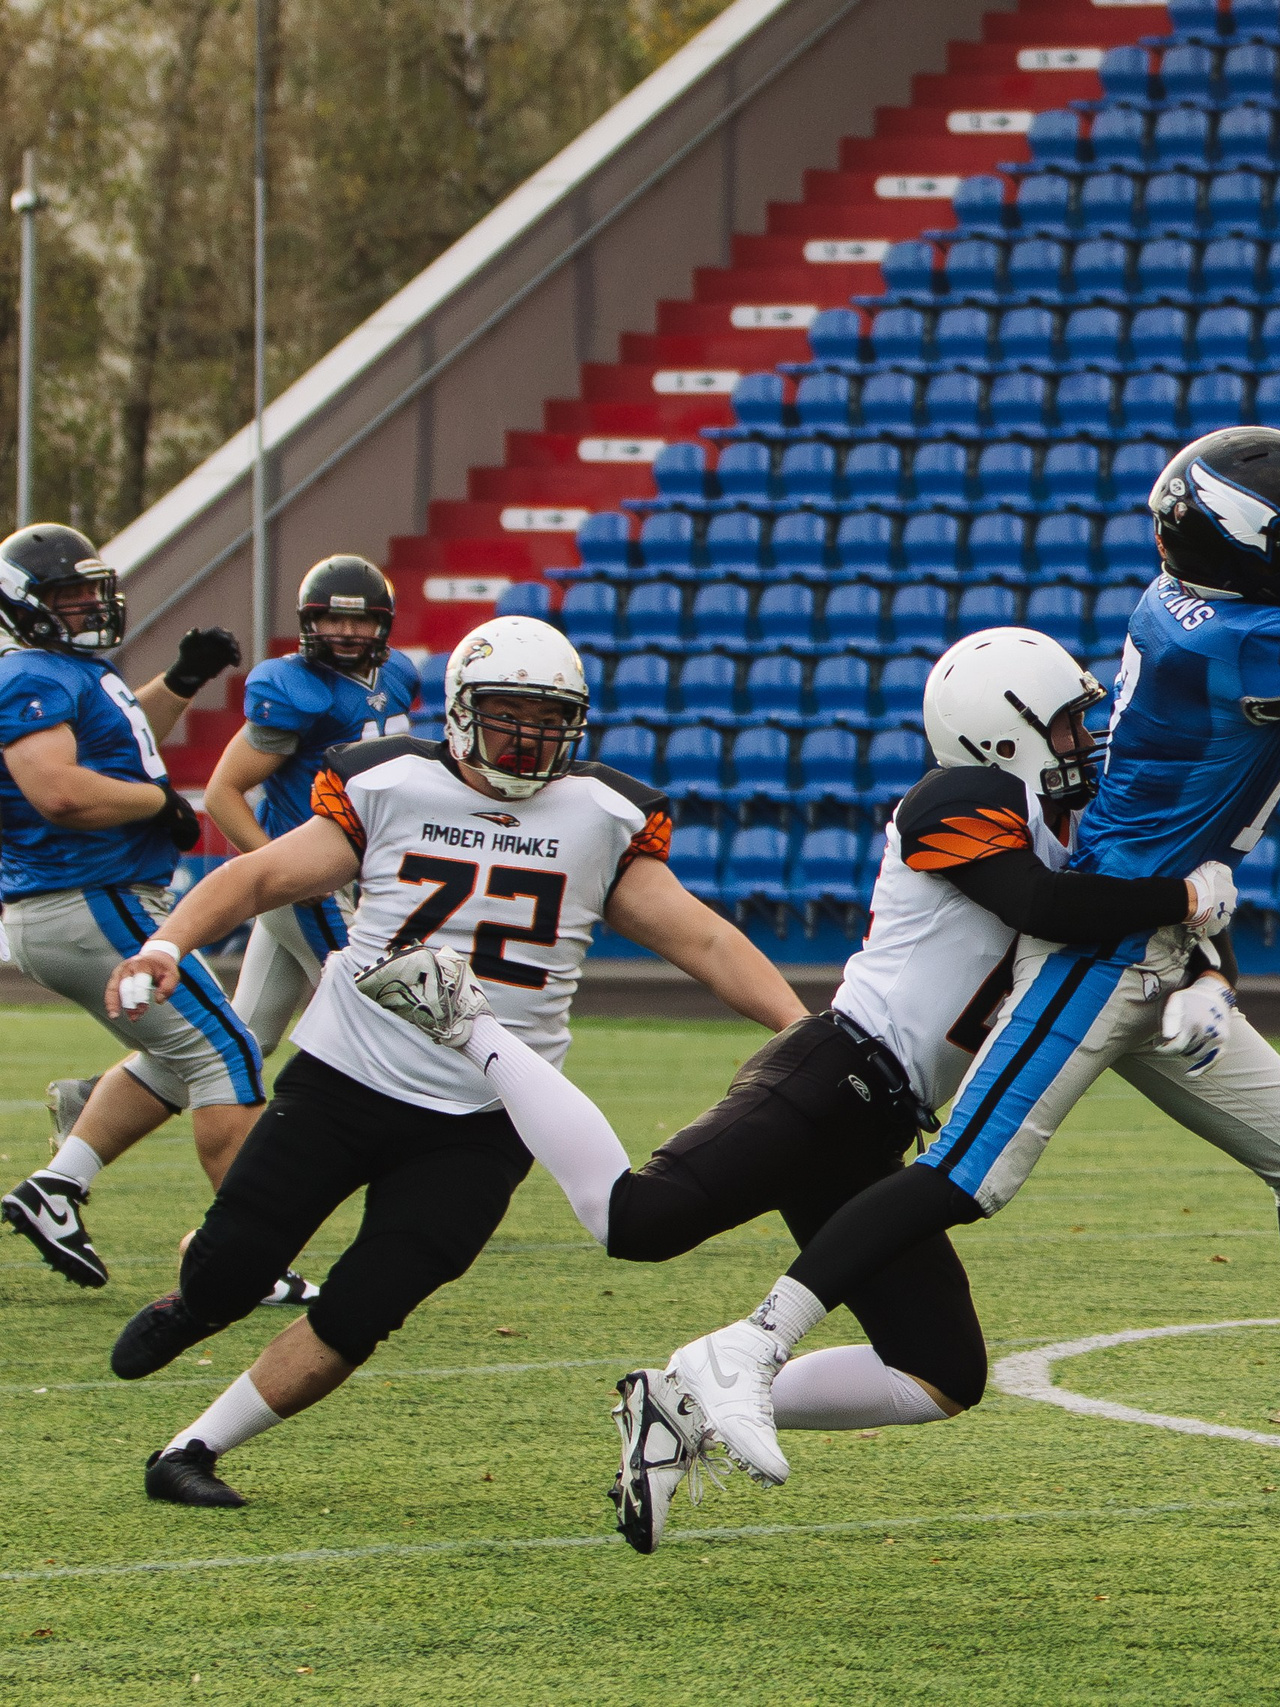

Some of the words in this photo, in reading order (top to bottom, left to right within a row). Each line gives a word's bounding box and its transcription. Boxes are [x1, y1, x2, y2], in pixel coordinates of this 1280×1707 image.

[421, 823, 486, 849] AMBER
[491, 833, 560, 859] HAWKS
[386, 851, 568, 991] 72
